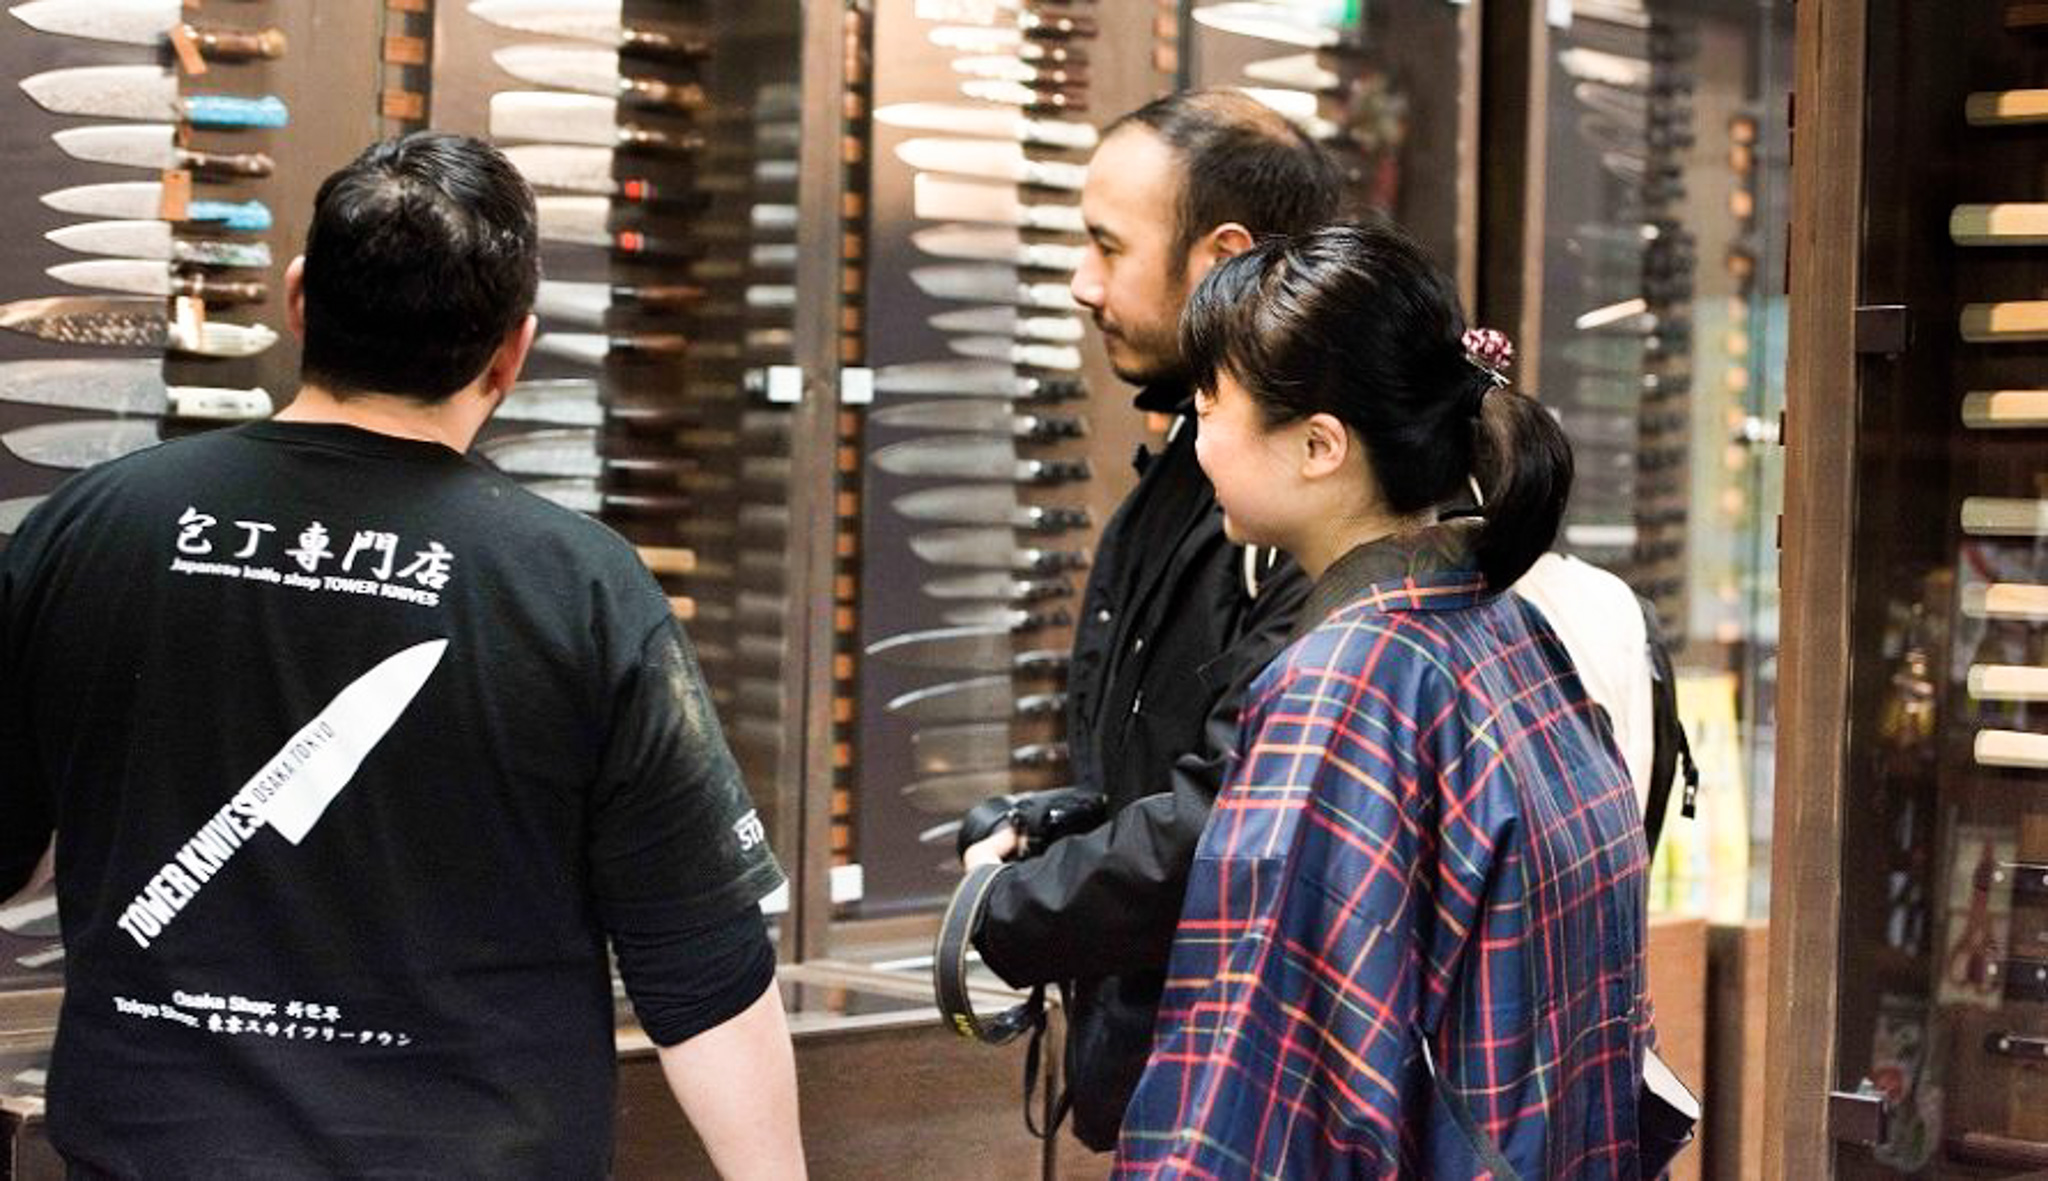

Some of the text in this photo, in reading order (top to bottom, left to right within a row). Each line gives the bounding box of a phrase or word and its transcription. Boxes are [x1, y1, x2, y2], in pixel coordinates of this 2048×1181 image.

[177, 506, 454, 589] 包丁専門店
[170, 558, 440, 606] Japanese knife shop TOWER KNIVES
[251, 720, 336, 803] OSAKA TOKYO
[117, 799, 265, 948] TOWER KNIVES
[113, 996, 159, 1019] Tokyo
[173, 990, 226, 1011] Osaka
[228, 996, 277, 1018] Shop:
